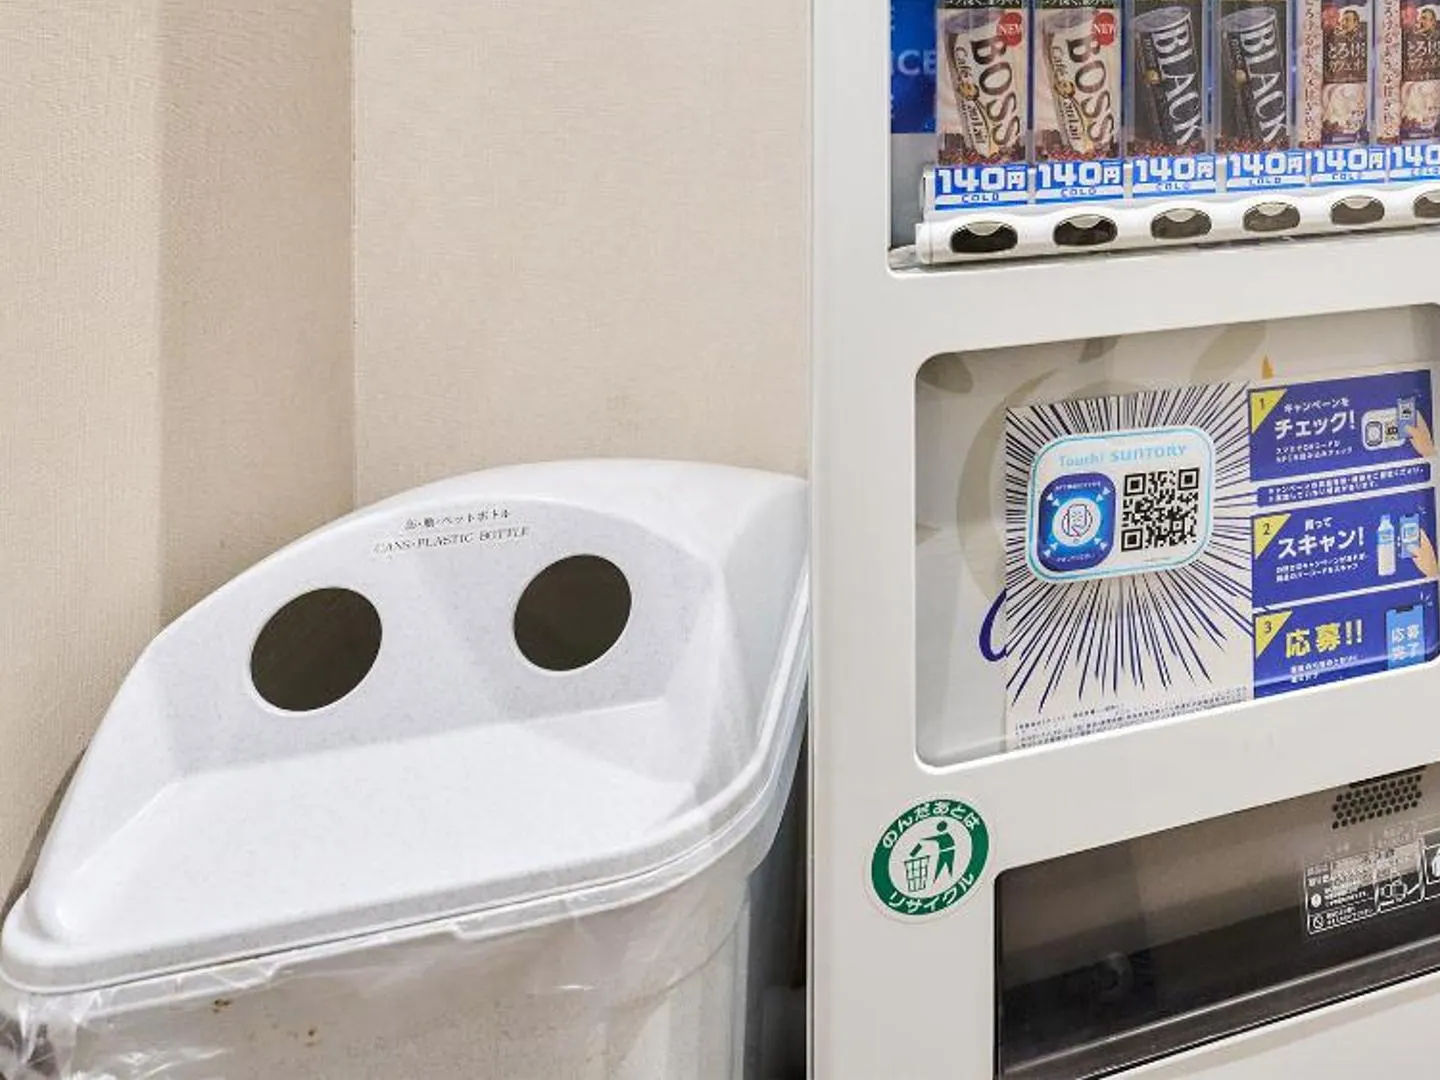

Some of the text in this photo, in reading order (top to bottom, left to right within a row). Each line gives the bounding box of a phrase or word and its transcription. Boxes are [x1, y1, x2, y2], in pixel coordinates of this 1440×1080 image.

[970, 35, 1021, 145] BOSS
[1066, 35, 1115, 142] BOSS
[1151, 21, 1202, 145] BLACK
[1240, 23, 1288, 142] BLACK
[1136, 158, 1212, 181] 140円
[1231, 153, 1305, 175] 140円
[1314, 148, 1384, 171] 140円
[938, 168, 1025, 192] 140円
[1039, 162, 1122, 187] 140円
[1111, 444, 1187, 463] SUNTORY
[888, 874, 975, 913] リサイクル
